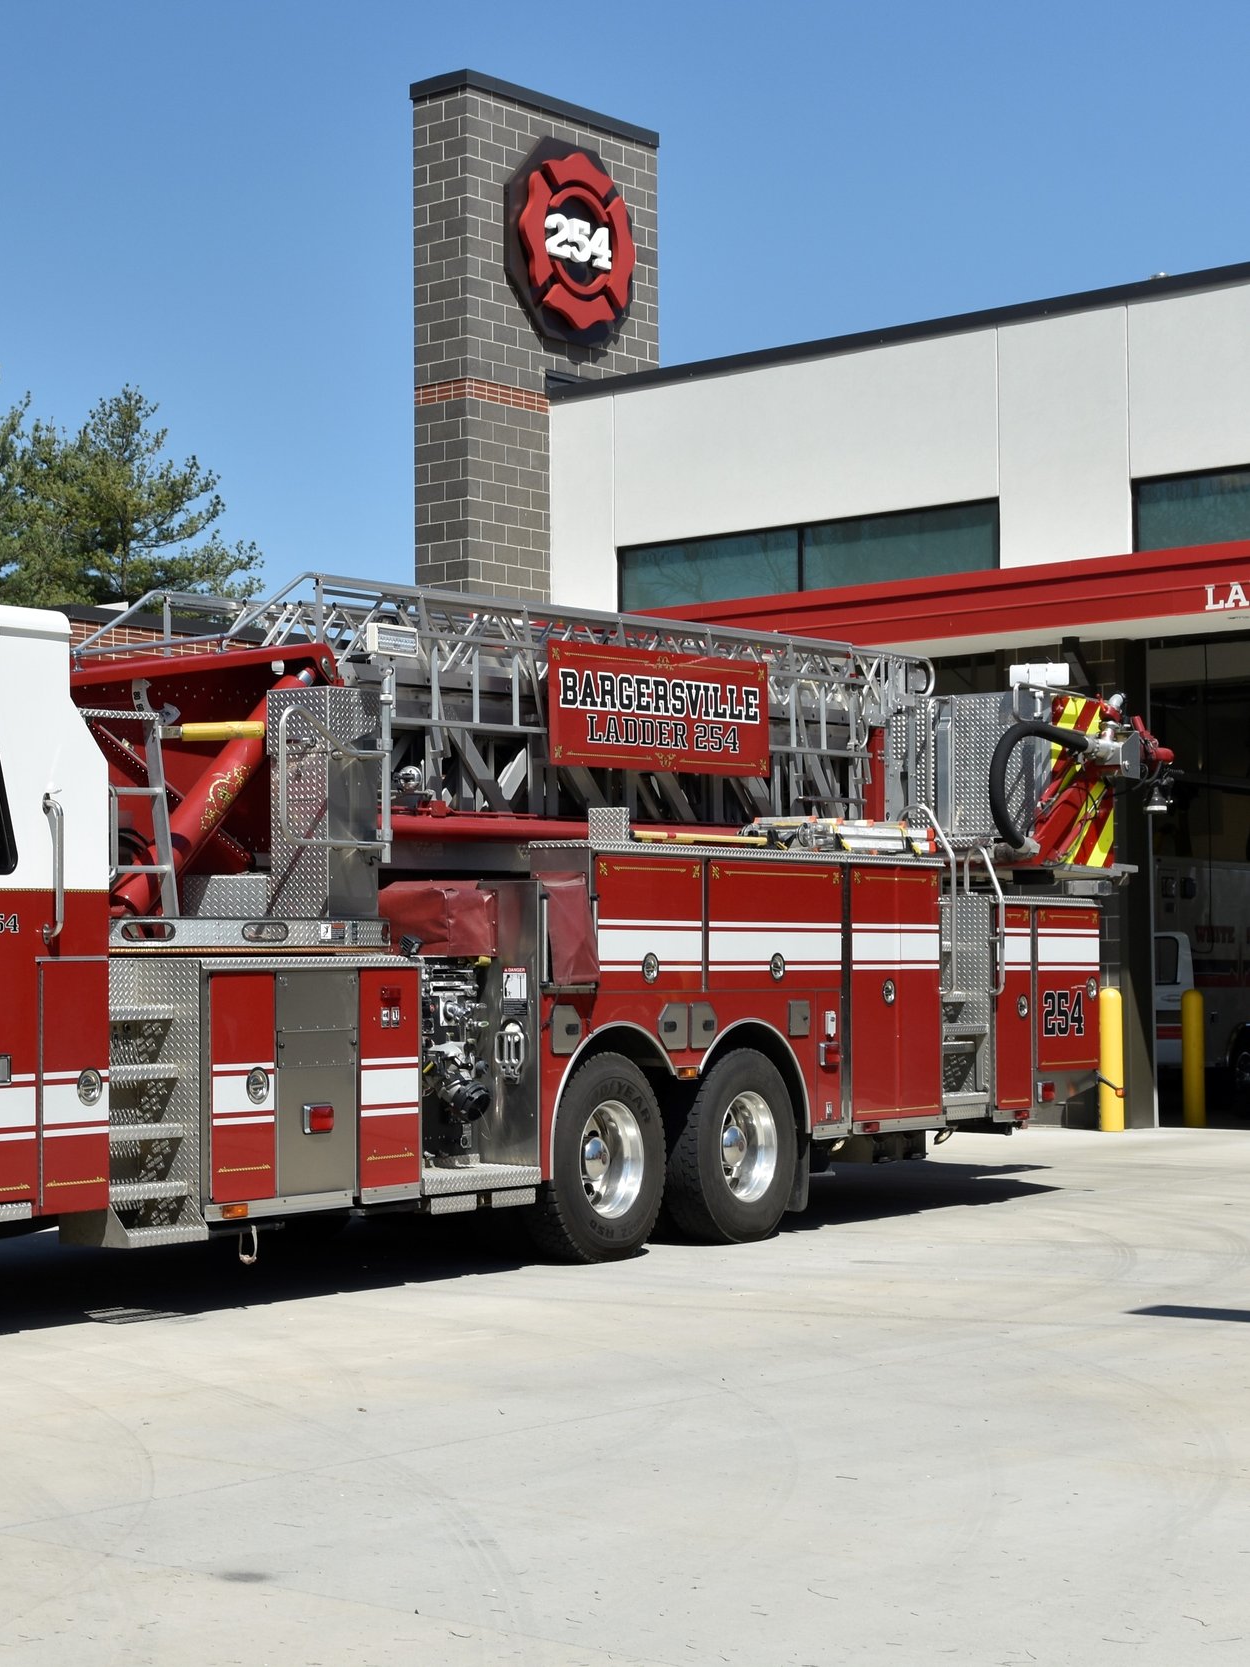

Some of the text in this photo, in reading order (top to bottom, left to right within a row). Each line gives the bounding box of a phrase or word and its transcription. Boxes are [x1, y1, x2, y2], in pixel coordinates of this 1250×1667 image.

[544, 213, 612, 270] 254
[559, 668, 760, 724] BARGERSVILLE
[587, 714, 739, 754] LADDER 254
[1043, 990, 1085, 1037] 254
